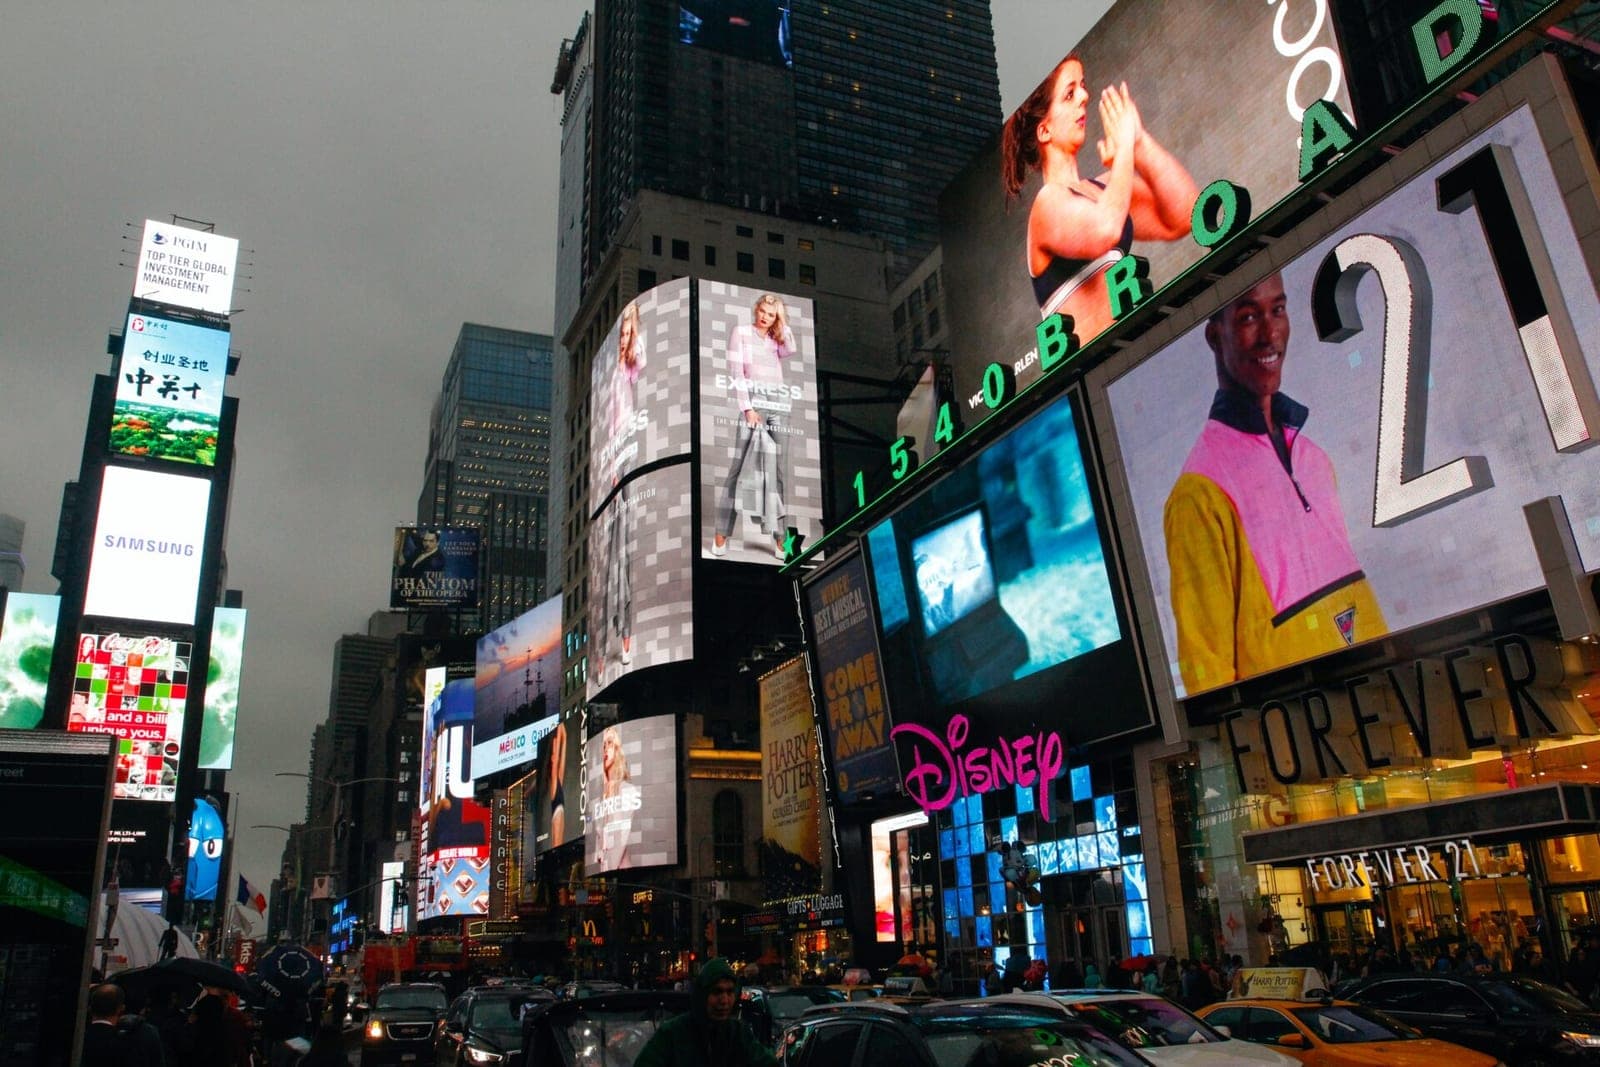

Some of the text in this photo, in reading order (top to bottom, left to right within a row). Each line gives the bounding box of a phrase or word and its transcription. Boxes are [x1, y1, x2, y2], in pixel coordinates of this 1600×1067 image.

[172, 236, 208, 253] PGIM
[145, 261, 206, 282] INVESTMENT
[147, 249, 229, 276] TOP TIER GLOBAL
[143, 272, 211, 294] MANAGEMENT
[1311, 143, 1592, 527] 21
[143, 349, 210, 372] 创业圣地
[715, 373, 802, 401] EXPRESS
[853, 362, 1005, 508] 1540
[104, 534, 194, 557] SAMSUNG
[394, 577, 476, 592] PHANTOM
[400, 589, 468, 599] OF THE OPERA
[832, 586, 866, 624] MUSICAL
[824, 651, 878, 702] COME
[107, 711, 133, 723] and
[134, 714, 144, 724] a
[1221, 632, 1560, 795] FOREVER
[129, 727, 163, 740] yous.
[836, 710, 885, 760] AWAY
[769, 728, 813, 772] HARRY
[767, 760, 815, 805] POTTER
[496, 798, 508, 891] PALACE
[1305, 839, 1482, 891] FOREVER 21
[787, 894, 844, 915] GIFTS LUGGAGE
